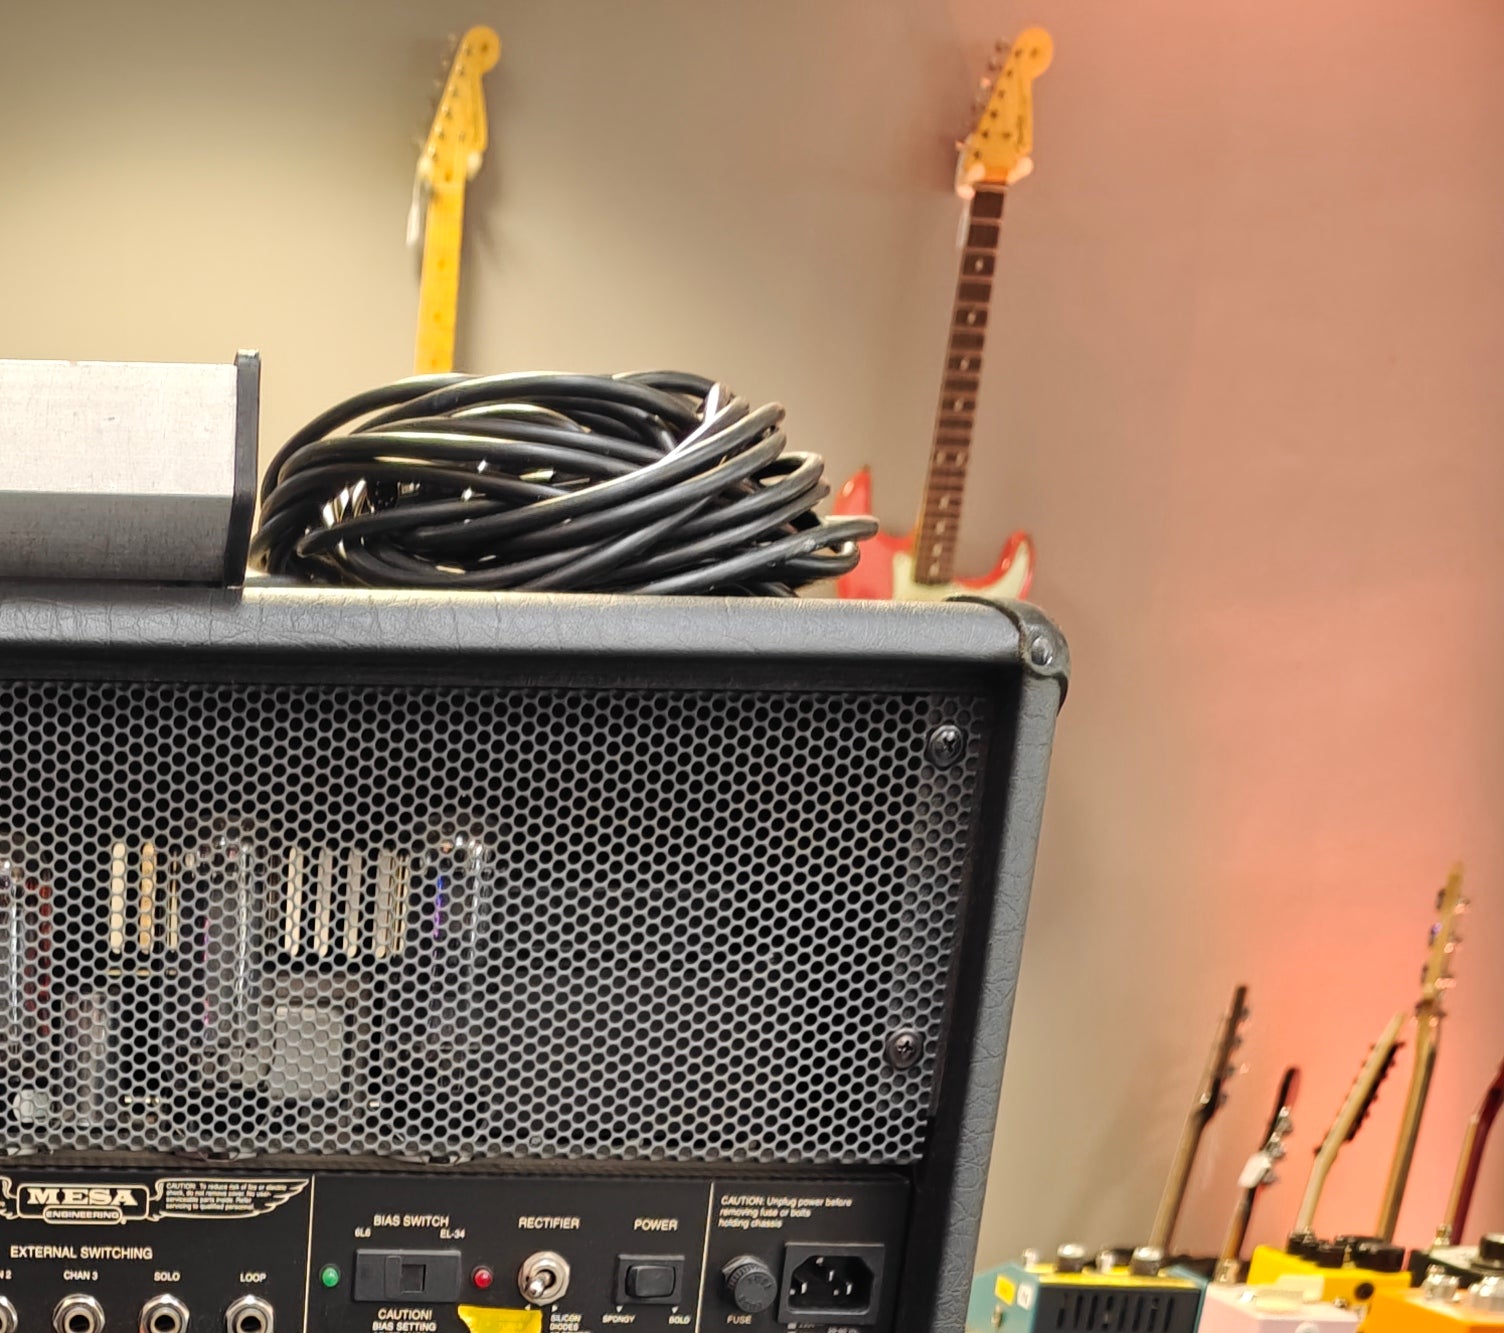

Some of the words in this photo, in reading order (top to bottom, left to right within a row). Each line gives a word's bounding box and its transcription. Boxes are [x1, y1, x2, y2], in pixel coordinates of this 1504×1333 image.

[26, 1188, 139, 1206] MESA
[766, 1196, 797, 1208] Unplug
[797, 1198, 824, 1208] power
[825, 1198, 853, 1207] before
[45, 1211, 119, 1219] ENGINEERING
[760, 1208, 779, 1217] fuse
[779, 1209, 790, 1217] or
[373, 1215, 401, 1227] BIAS
[403, 1215, 450, 1228] SWITCH
[518, 1216, 581, 1230] RECTIFIER
[633, 1218, 679, 1232] POWER
[439, 1229, 466, 1239] EL-34
[10, 1245, 78, 1259] EXTERNAL
[80, 1246, 153, 1260] SWITCHING
[5, 1269, 12, 1280] 2
[63, 1270, 91, 1281] CHAN
[92, 1271, 99, 1281] 3
[154, 1272, 181, 1282] SOLO
[240, 1272, 267, 1283] LOOP
[377, 1308, 433, 1321] CAUTION!
[727, 1315, 753, 1325] FUSE
[372, 1321, 394, 1331] BIAS
[396, 1321, 437, 1332] SETTING
